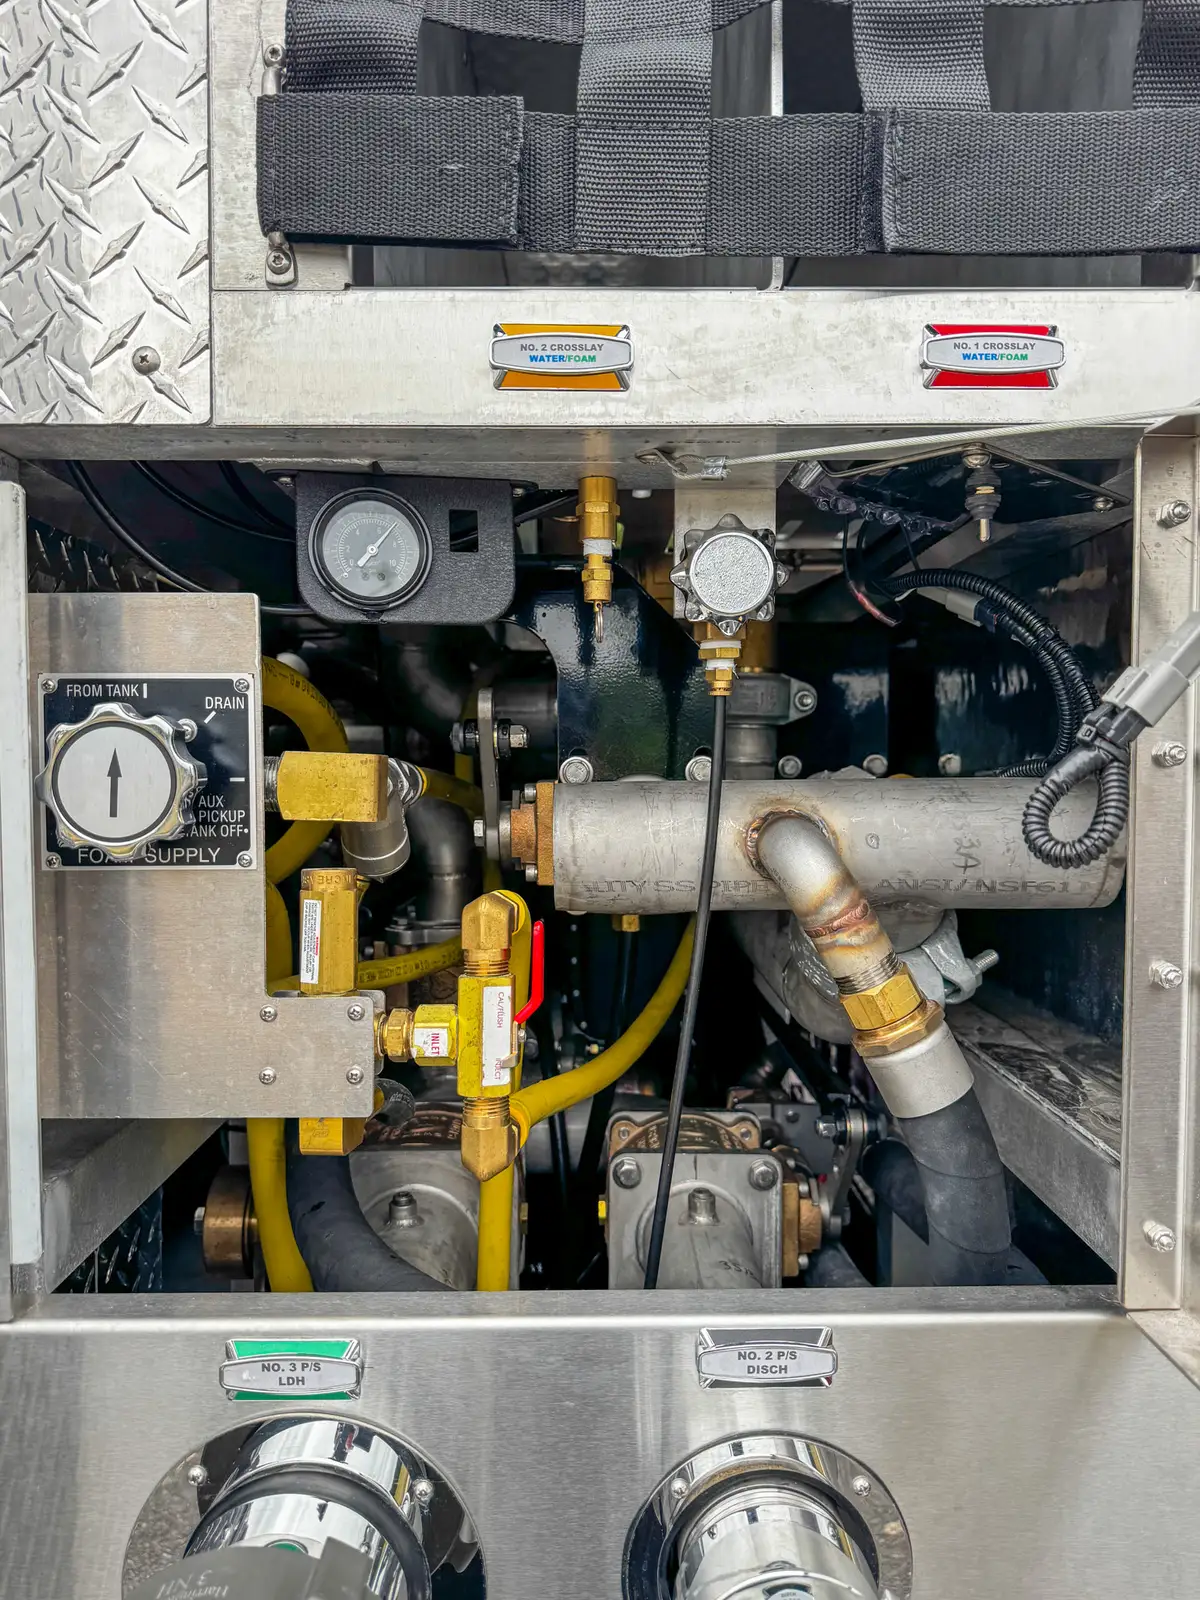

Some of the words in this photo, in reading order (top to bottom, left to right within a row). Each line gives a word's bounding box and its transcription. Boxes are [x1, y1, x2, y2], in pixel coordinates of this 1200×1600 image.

[953, 342, 972, 350] NO.
[974, 342, 980, 350] 1
[983, 342, 1036, 350] CROSSLAY
[66, 683, 103, 698] FROM
[106, 683, 139, 698] TANK
[205, 696, 245, 710] DRAIN
[198, 795, 224, 808] AUX
[199, 810, 246, 823] PICKUP
[185, 824, 217, 838] ANK
[220, 824, 243, 838] OFF
[78, 848, 133, 863] FO
[144, 847, 221, 863] SUPPLY
[431, 1032, 440, 1055] INLET
[738, 1351, 761, 1360] NO.
[765, 1351, 773, 1360] 2
[777, 1351, 797, 1360] P/S
[261, 1363, 284, 1372] NO.
[290, 1363, 297, 1372] 3
[301, 1363, 321, 1372] P/S
[747, 1365, 787, 1374] DISCH
[278, 1376, 305, 1386] LDH
